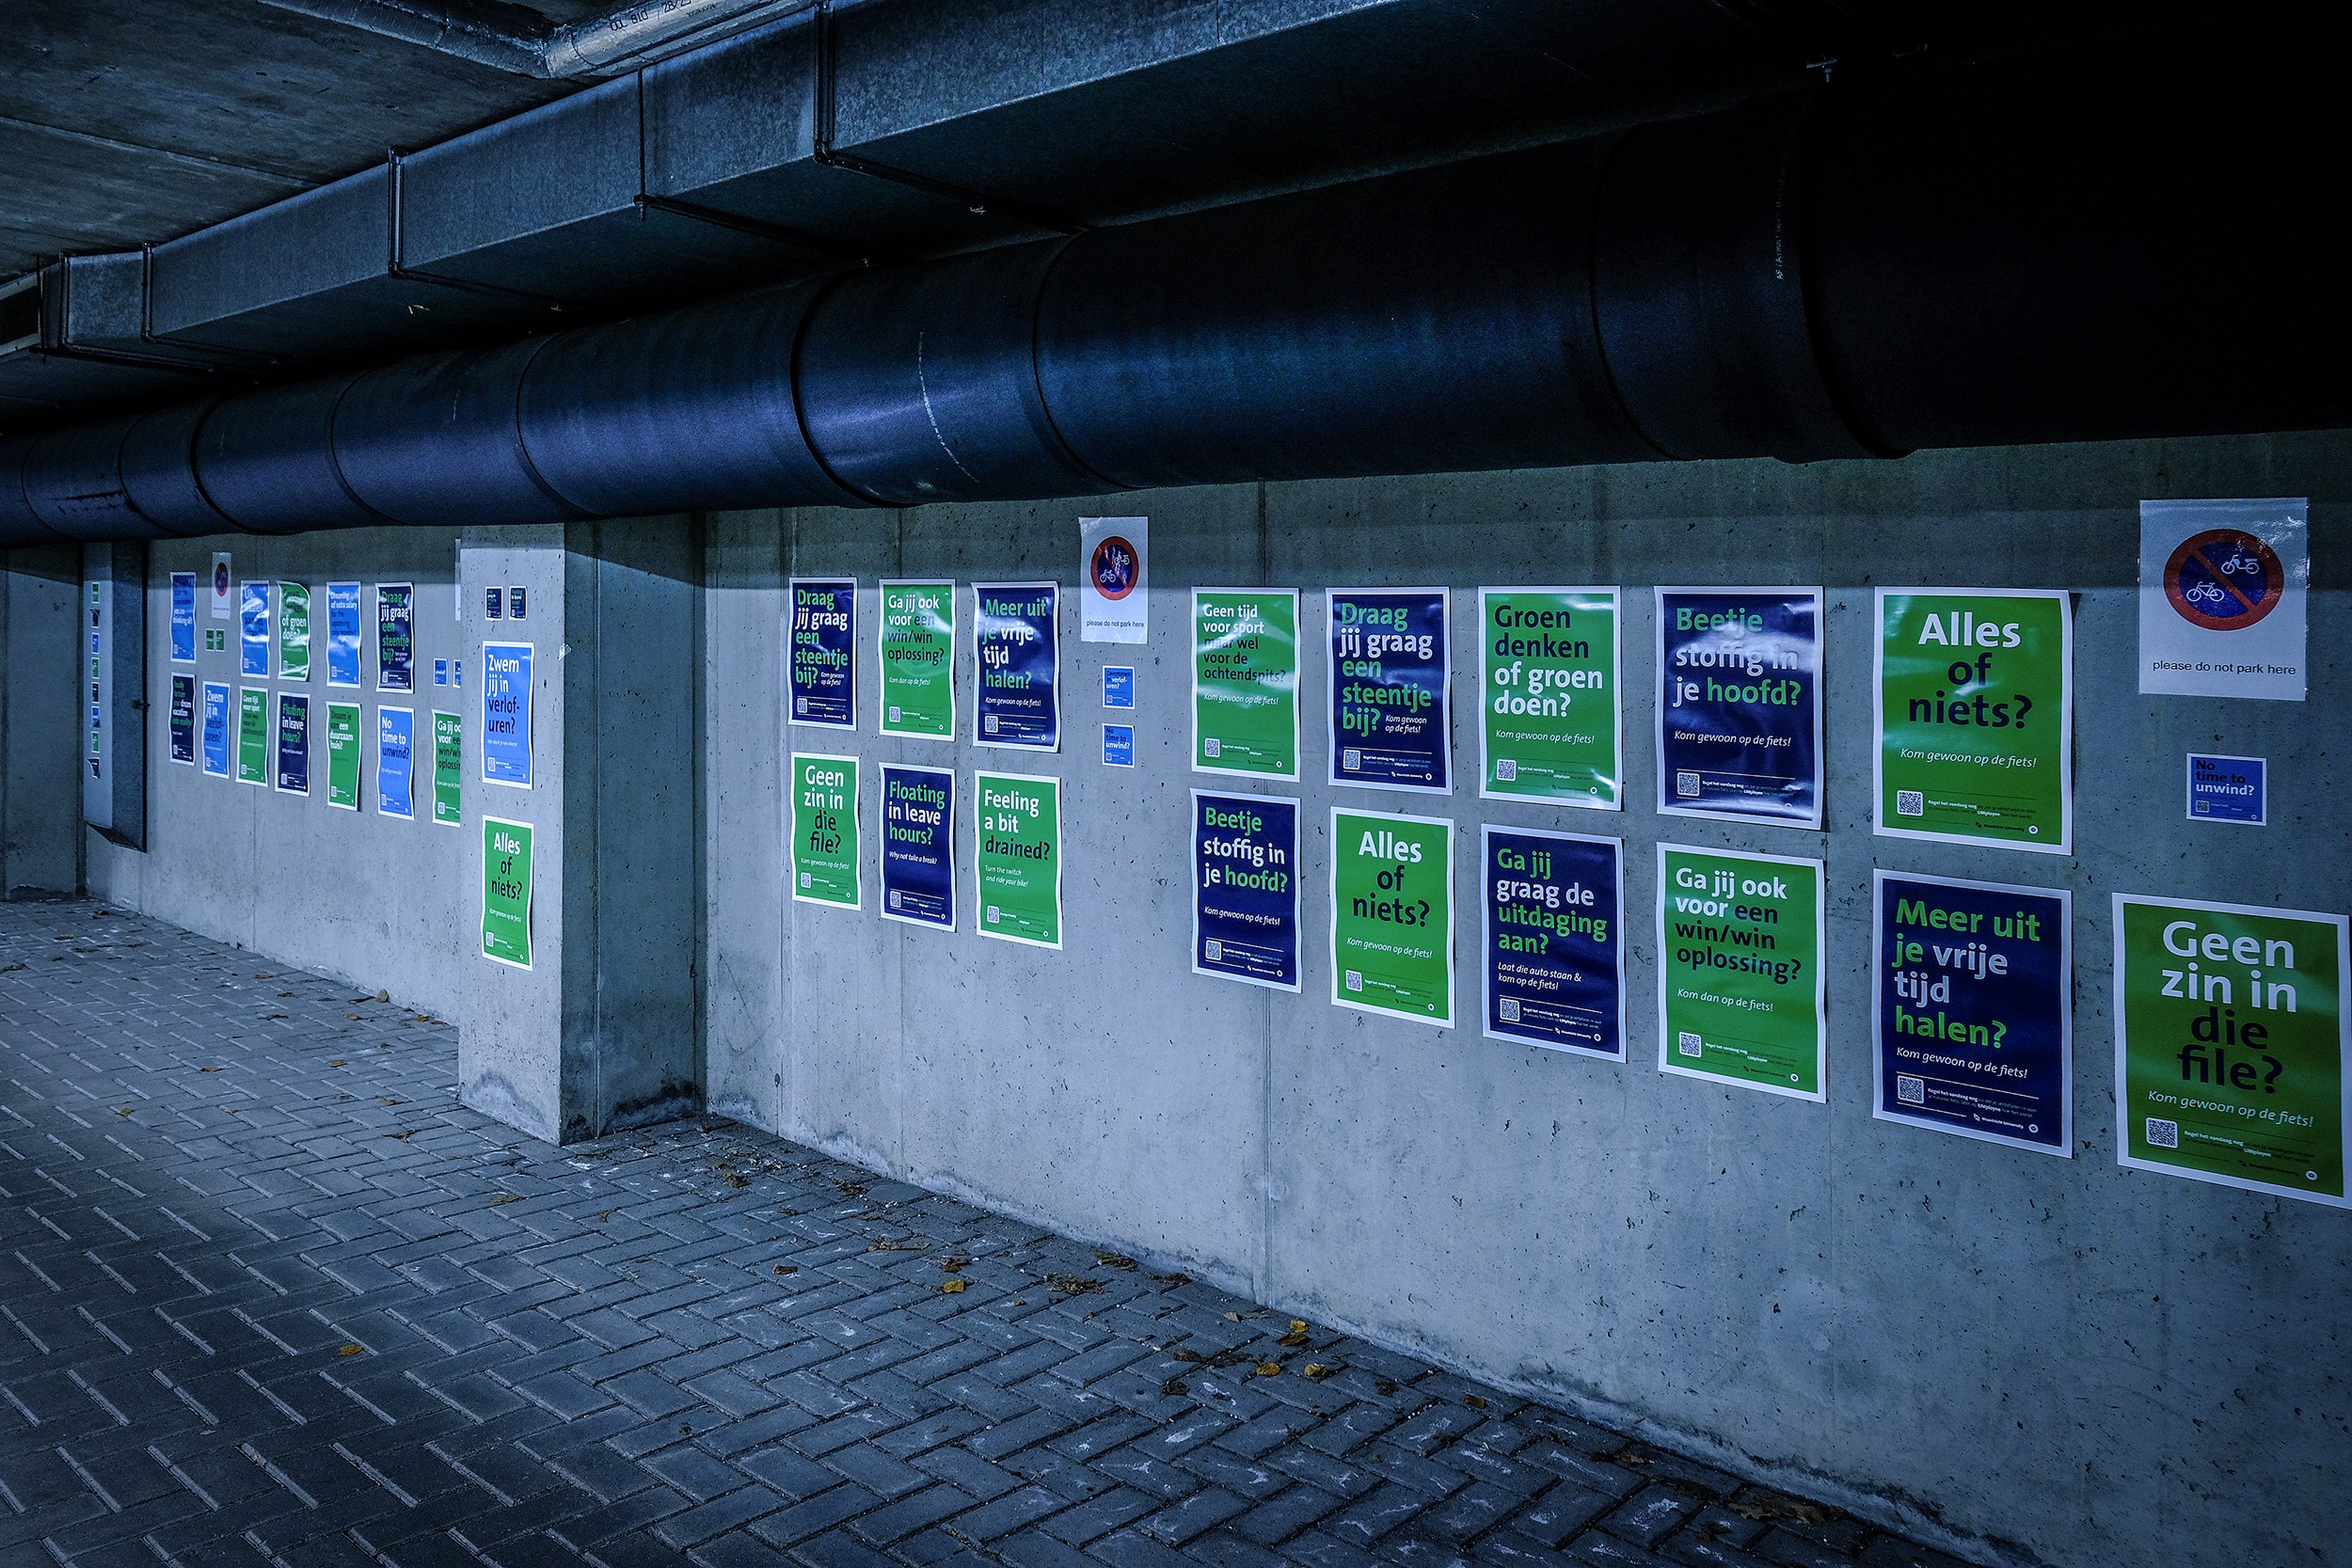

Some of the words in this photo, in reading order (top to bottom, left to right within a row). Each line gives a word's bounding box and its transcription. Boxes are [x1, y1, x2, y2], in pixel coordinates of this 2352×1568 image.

[381, 591, 403, 607] Draag
[797, 589, 834, 610] Draag
[888, 594, 903, 609] Ga
[904, 594, 915, 612] jij
[917, 594, 940, 610] ook
[985, 598, 1023, 616] Meer
[1026, 598, 1046, 617] uit
[380, 605, 389, 622] jij
[390, 608, 409, 622] graag
[795, 608, 810, 630] jij
[810, 611, 849, 631] graag
[888, 614, 913, 626] voor
[914, 615, 936, 626] een
[1086, 620, 1103, 628] please
[1203, 604, 1233, 618] Geen
[1237, 605, 1258, 621] tijd
[1341, 603, 1408, 632] Draag
[1495, 605, 1571, 628] Groen
[382, 622, 395, 632] een
[796, 631, 819, 645] een
[887, 629, 933, 643] win/win
[982, 625, 996, 645] je
[1000, 621, 1034, 646] vrije
[1203, 622, 1231, 633] voor
[1232, 621, 1264, 638] sport
[1918, 611, 2021, 647] Alles
[382, 634, 409, 651] steentje
[1236, 637, 1259, 649] wel
[1339, 627, 1361, 657] jij
[1367, 634, 1433, 659] graag
[1495, 632, 1589, 658] denken
[382, 648, 394, 665] bij?
[488, 654, 519, 673] Zwem
[795, 647, 849, 671] steentje
[888, 646, 945, 666] oplossing?
[983, 645, 1009, 669] tijd
[1203, 653, 1230, 664] voor
[1233, 652, 1248, 665] de
[2153, 660, 2192, 673] please
[2195, 661, 2211, 672] do
[2215, 661, 2234, 673] not
[2236, 663, 2265, 675] park
[2267, 664, 2296, 675] here
[796, 665, 818, 689] bij?
[985, 669, 1033, 689] halen?
[1204, 666, 1286, 685] ochtendspits?
[1342, 659, 1382, 677] een
[1495, 660, 1522, 685] of
[1528, 668, 1603, 694] groen
[1947, 652, 1993, 687] of
[487, 673, 498, 698] jij
[500, 674, 509, 693] in
[1673, 676, 1700, 707] je
[1707, 677, 1802, 705] hoofd?
[488, 695, 519, 713] verlof-
[1343, 682, 1432, 713] steentje
[1494, 689, 1571, 718] doen?
[1909, 690, 2032, 729] niets?
[382, 717, 392, 729] No
[488, 717, 516, 734] uren?
[1343, 706, 1381, 737] bij?
[382, 730, 398, 744] time
[399, 733, 406, 745] to
[382, 746, 410, 759] unwind?
[805, 765, 845, 788] Geen
[2196, 760, 2216, 771] No
[2195, 771, 2227, 784] time
[2231, 773, 2248, 784] to
[803, 787, 825, 808] zin
[829, 788, 844, 810] in
[889, 781, 946, 809] Floating
[2195, 783, 2255, 797] unwind?
[888, 800, 901, 820] in
[905, 802, 942, 825] leave
[984, 789, 1040, 818] Feeling
[814, 810, 836, 831] die
[984, 816, 993, 831] a
[998, 813, 1019, 833] bit
[1205, 807, 1263, 836] Beetje
[493, 832, 521, 855] Alles
[810, 831, 841, 854] file?
[889, 821, 933, 846] hours?
[985, 835, 1050, 861] drained?
[1203, 837, 1264, 866] stoffig
[1268, 843, 1285, 864] in
[1358, 831, 1422, 863] Alles
[501, 856, 513, 875] of
[1496, 847, 1524, 870] Ga
[1529, 850, 1551, 879] jij
[491, 877, 523, 900] niets?
[1203, 862, 1221, 887] je
[1225, 865, 1288, 893] hoofd?
[1376, 865, 1405, 892] of
[1676, 867, 1707, 890] Ga
[1711, 870, 1735, 899] jij
[1741, 877, 1788, 900] ook
[1496, 879, 1559, 908] graag
[1565, 882, 1594, 906] de
[1352, 893, 1430, 927] niets?
[1675, 896, 1728, 918] voor
[1734, 905, 1778, 925] een
[1896, 898, 1983, 933] Meer
[1994, 911, 2041, 942] uit
[1497, 903, 1607, 942] uitdaging
[1497, 933, 1549, 956] aan?
[1675, 920, 1776, 950] win/win
[2162, 921, 2295, 969] Geen
[1677, 946, 1802, 985] oplossing?
[1891, 933, 1924, 968] je
[1932, 942, 2009, 979] vrije
[1497, 961, 1515, 974] Laat
[1516, 964, 1529, 974] die
[1529, 967, 1548, 978] auto
[1549, 970, 1572, 981] staan
[1572, 973, 1581, 983] &
[1497, 972, 1515, 983] kom
[1516, 976, 1526, 987] op
[1526, 977, 1537, 987] de
[1536, 979, 1558, 990] fiets!
[1894, 971, 1950, 1008] tijd
[2161, 961, 2232, 1005] zin
[2249, 969, 2296, 1013] in
[1677, 989, 1699, 1000] Kom
[1700, 991, 1720, 1004] dan
[1721, 995, 1735, 1008] op
[1736, 996, 1748, 1007] de
[1747, 998, 1773, 1012] fiets!
[1896, 1005, 2008, 1049] halen?
[2190, 1006, 2268, 1050] die
[2177, 1043, 2283, 1094] file?
[2148, 1090, 2178, 1104] Kom
[2180, 1096, 2234, 1114] gewoon
[2237, 1104, 2255, 1118] op
[2258, 1106, 2276, 1119] de
[2277, 1110, 2313, 1128] fiets!
